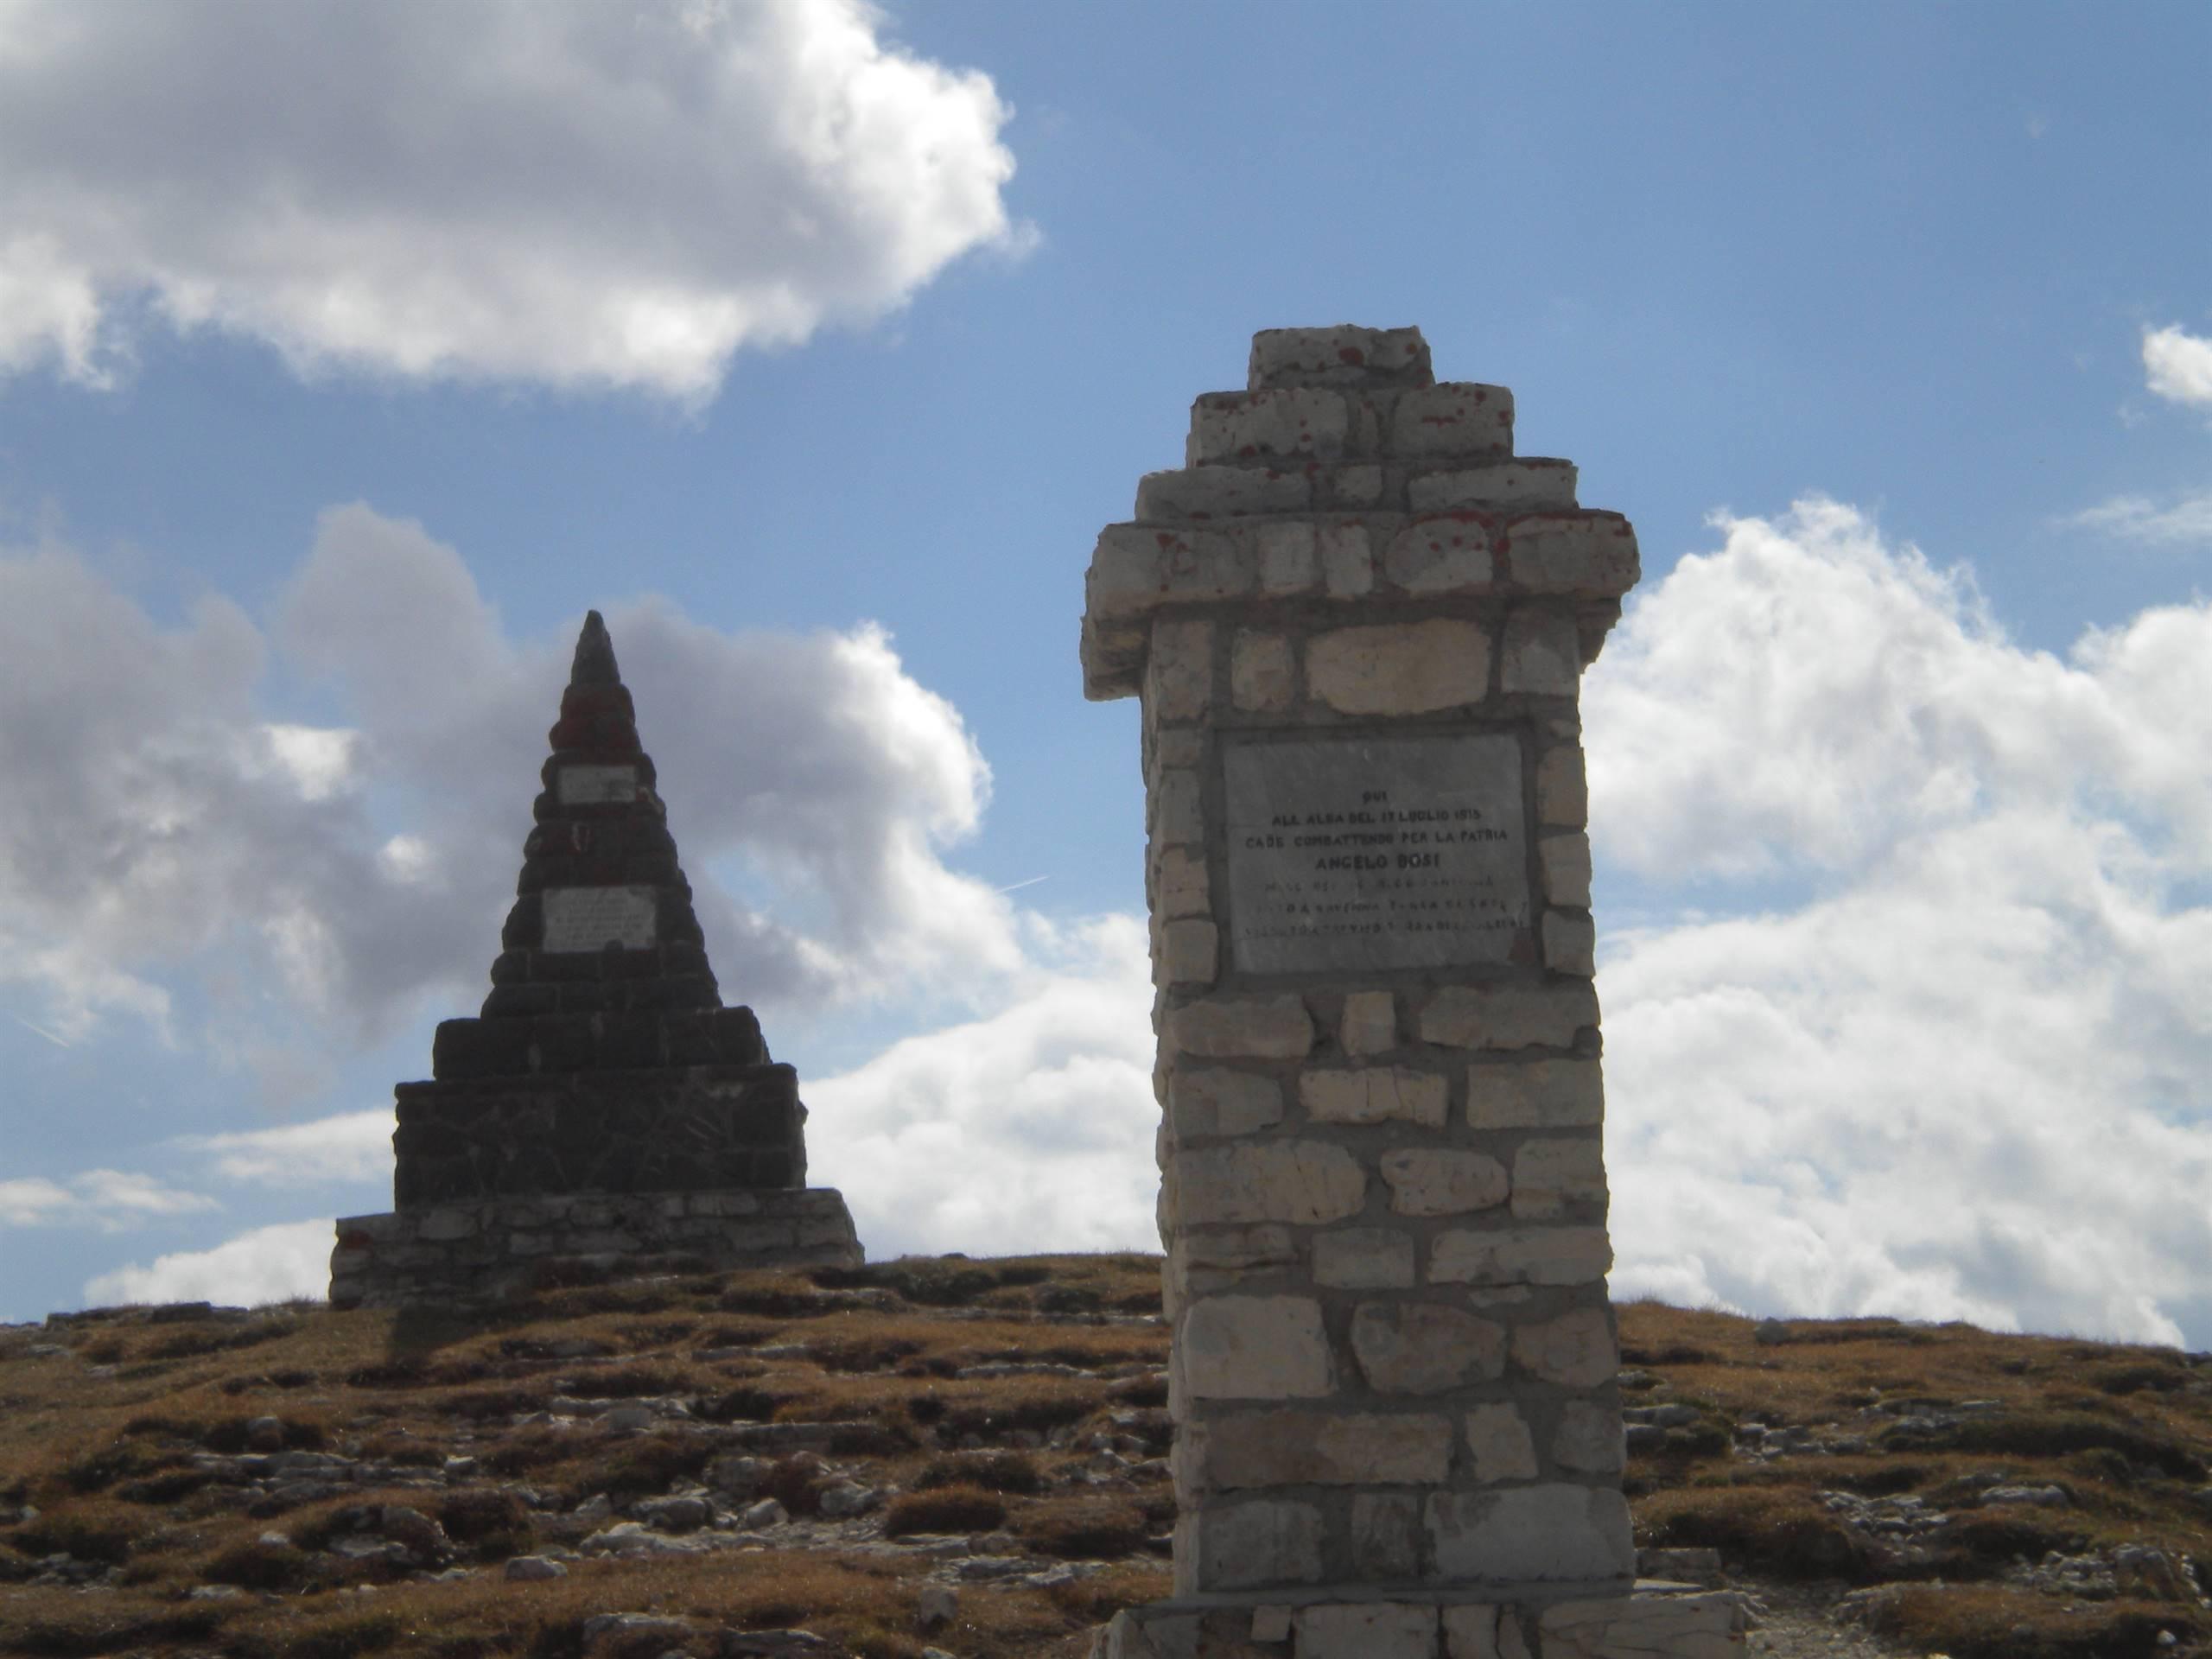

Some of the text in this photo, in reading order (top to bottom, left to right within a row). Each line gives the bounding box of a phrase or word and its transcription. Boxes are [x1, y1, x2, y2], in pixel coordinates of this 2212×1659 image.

[1306, 812, 1344, 824] ALBA
[1348, 811, 1375, 823] DEL
[1398, 809, 1449, 823] LUGLIO
[1454, 808, 1482, 821] 1915
[1294, 833, 1394, 848] COMBATTENDO
[1402, 831, 1427, 844] PER
[1435, 830, 1455, 843] LA
[1460, 828, 1508, 843] PATRIA
[1315, 852, 1440, 871] ANGELO BOSI
